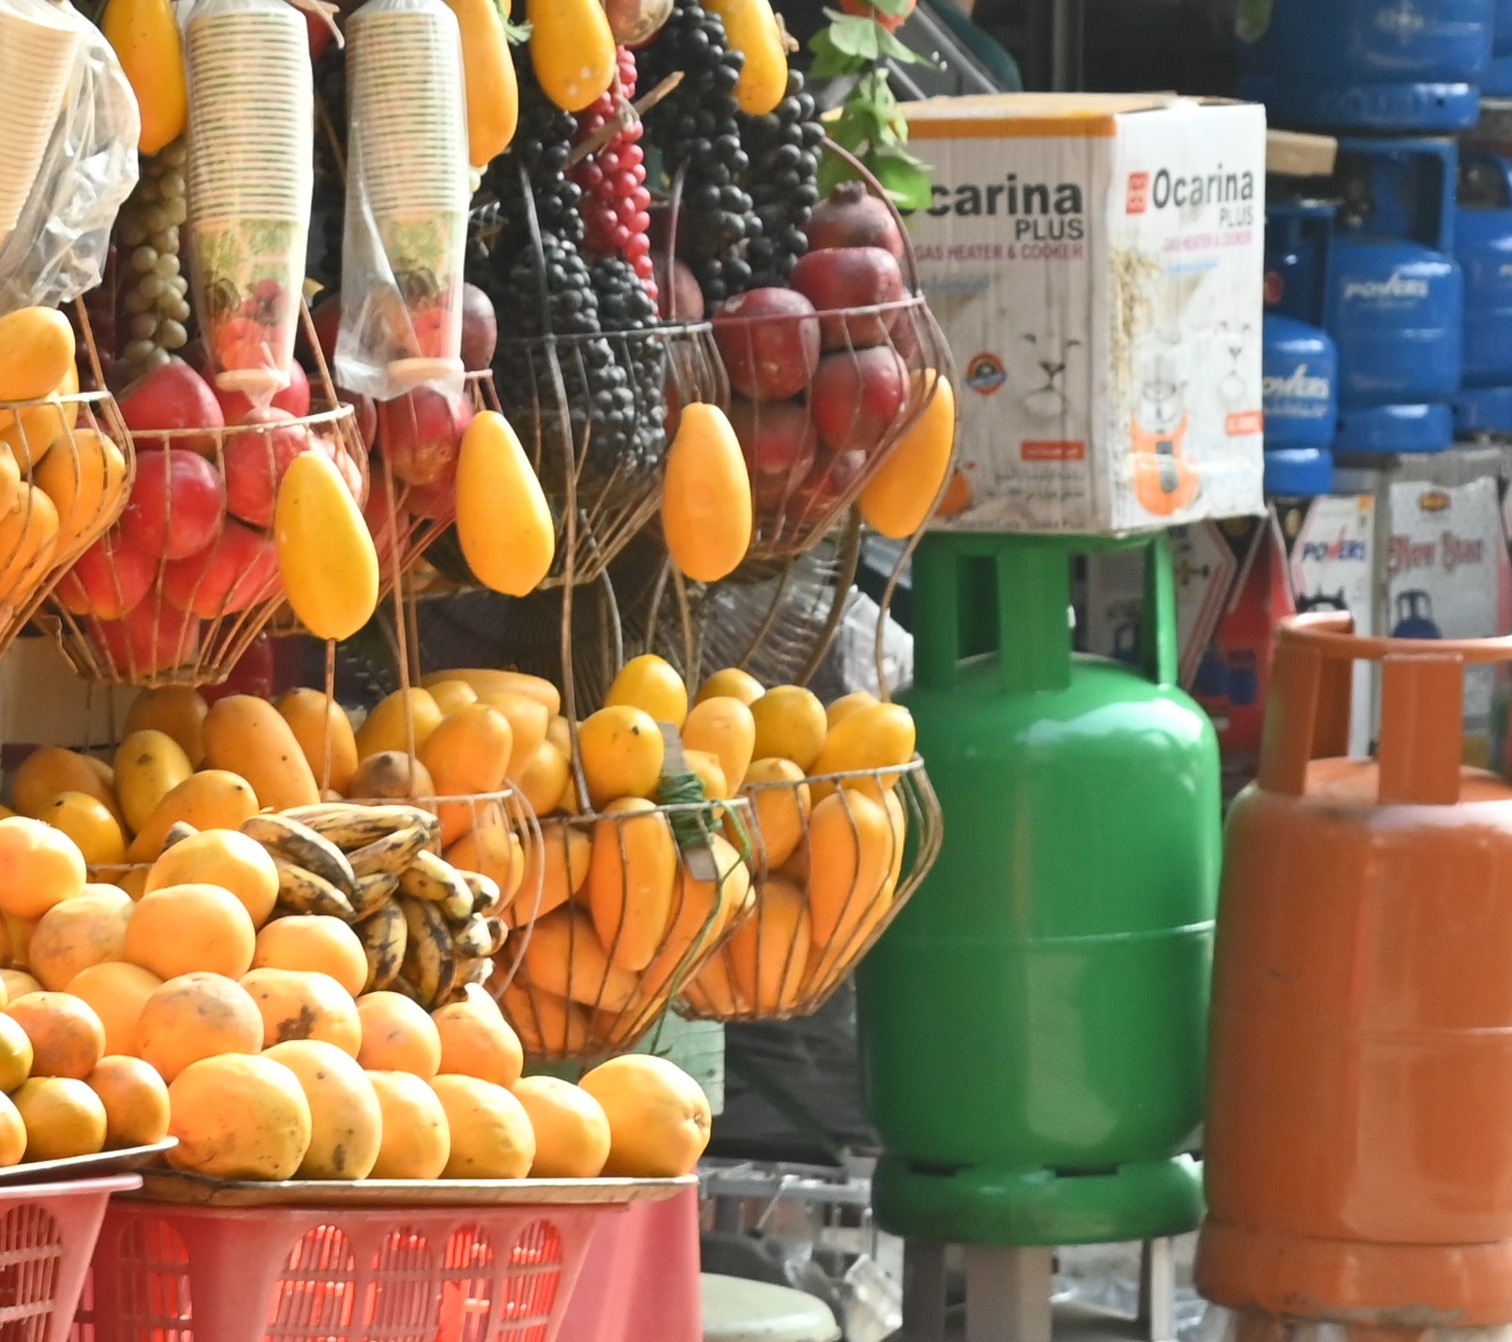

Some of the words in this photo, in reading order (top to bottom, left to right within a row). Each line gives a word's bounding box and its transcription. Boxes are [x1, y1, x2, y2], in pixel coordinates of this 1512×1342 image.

[897, 172, 1083, 217] carina
[1152, 162, 1255, 210] Ocarina
[1015, 218, 1084, 241] PLUS
[1219, 205, 1254, 229] PLUS
